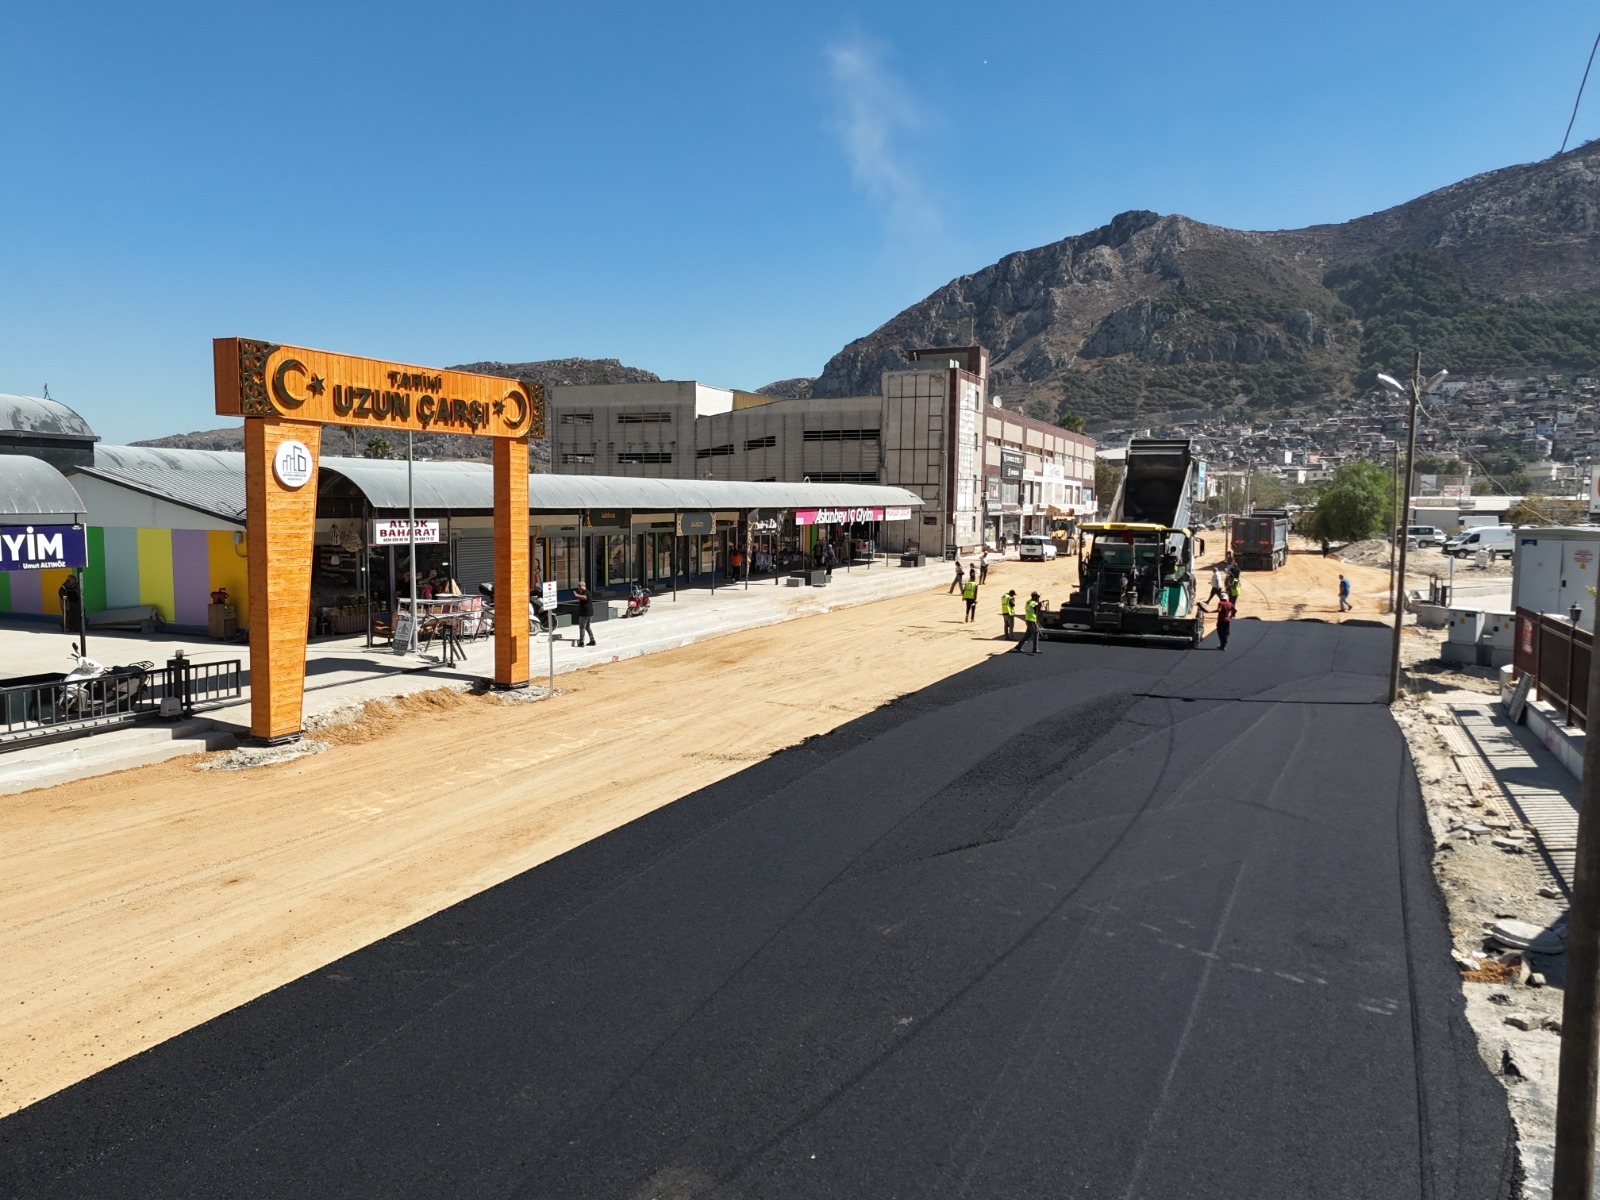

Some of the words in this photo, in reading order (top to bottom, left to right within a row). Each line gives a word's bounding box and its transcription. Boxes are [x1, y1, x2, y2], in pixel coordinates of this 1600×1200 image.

[333, 385, 410, 420] UZUN
[417, 394, 490, 432] ÇARŞI
[815, 508, 847, 526] Aslanbey
[0, 526, 64, 562] YİM
